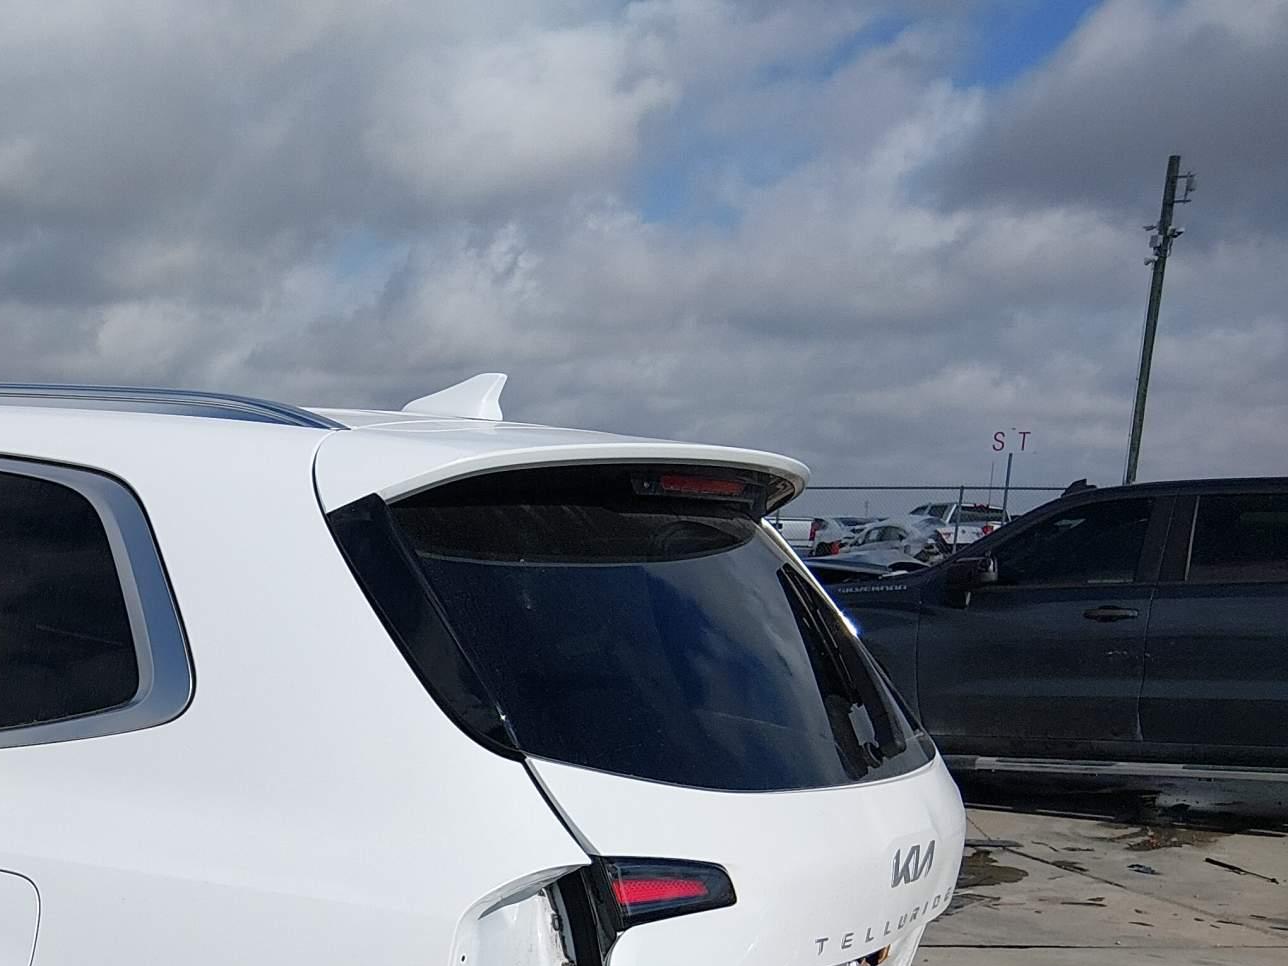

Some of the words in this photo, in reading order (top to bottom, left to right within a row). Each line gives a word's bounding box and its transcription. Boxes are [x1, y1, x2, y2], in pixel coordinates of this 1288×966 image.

[992, 431, 1005, 452] S
[1018, 431, 1032, 452] T
[891, 839, 936, 889] KIA
[814, 886, 953, 956] TELLURIDE
